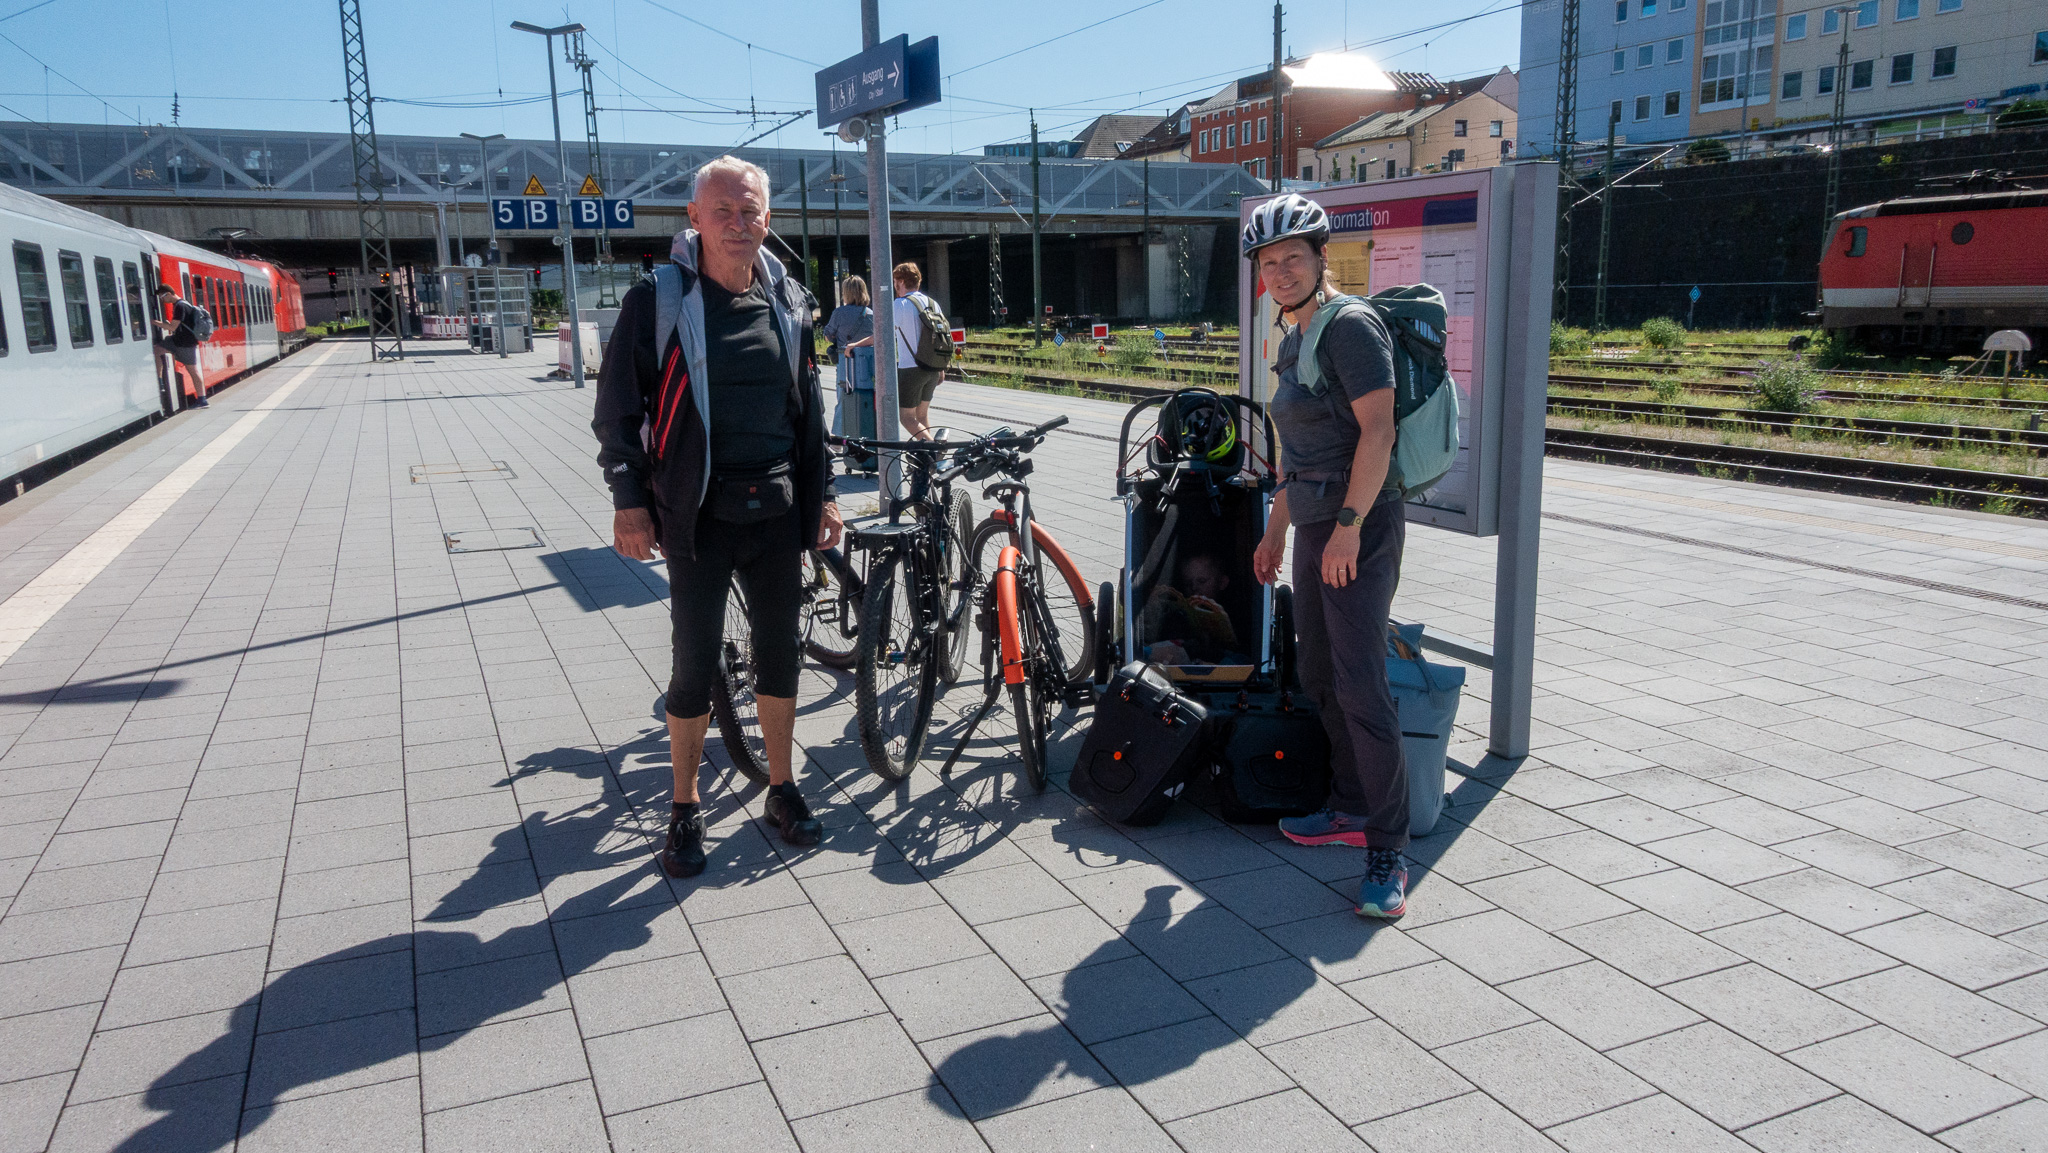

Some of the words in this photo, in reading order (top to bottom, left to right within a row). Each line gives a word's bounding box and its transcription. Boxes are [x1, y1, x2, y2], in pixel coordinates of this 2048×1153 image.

[862, 67, 884, 85] Ausgang
[498, 200, 514, 223] 5
[530, 200, 548, 223] B
[581, 200, 599, 223] B
[614, 200, 630, 223] 6
[1329, 207, 1389, 230] formation
